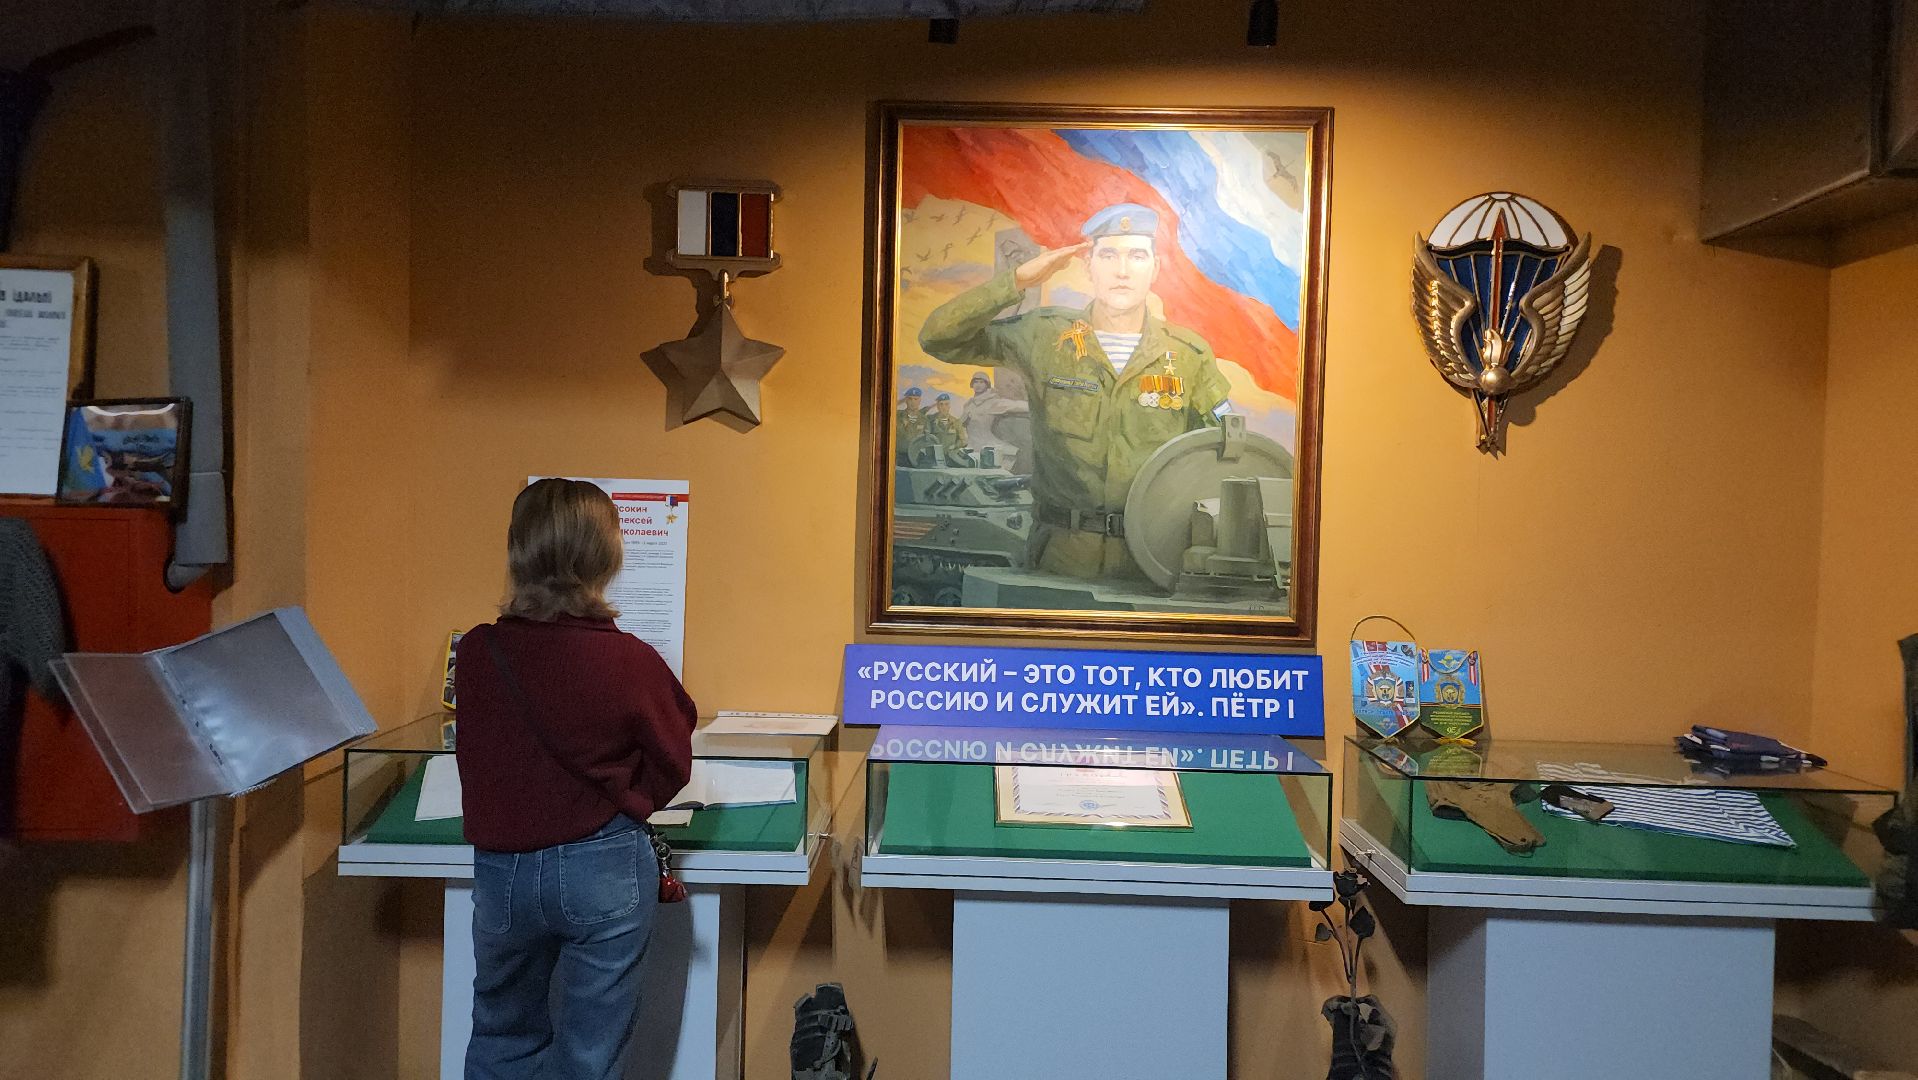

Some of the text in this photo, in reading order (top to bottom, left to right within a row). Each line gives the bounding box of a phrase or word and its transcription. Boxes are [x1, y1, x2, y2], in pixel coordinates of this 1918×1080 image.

[620, 528, 668, 536] колаевич
[857, 658, 997, 683] «РУССКИЙ
[1023, 664, 1076, 685] ЭТО
[1082, 665, 1141, 691] ТОТ,
[1148, 667, 1202, 688] КТО
[1209, 668, 1309, 691] ЛЮБИТ
[870, 689, 988, 712] РОССИЮ
[996, 691, 1013, 712] И
[1021, 692, 1139, 715] СЛУЖИТ
[1145, 691, 1204, 717] ЕЙ».
[1211, 692, 1281, 719] ПЁТР
